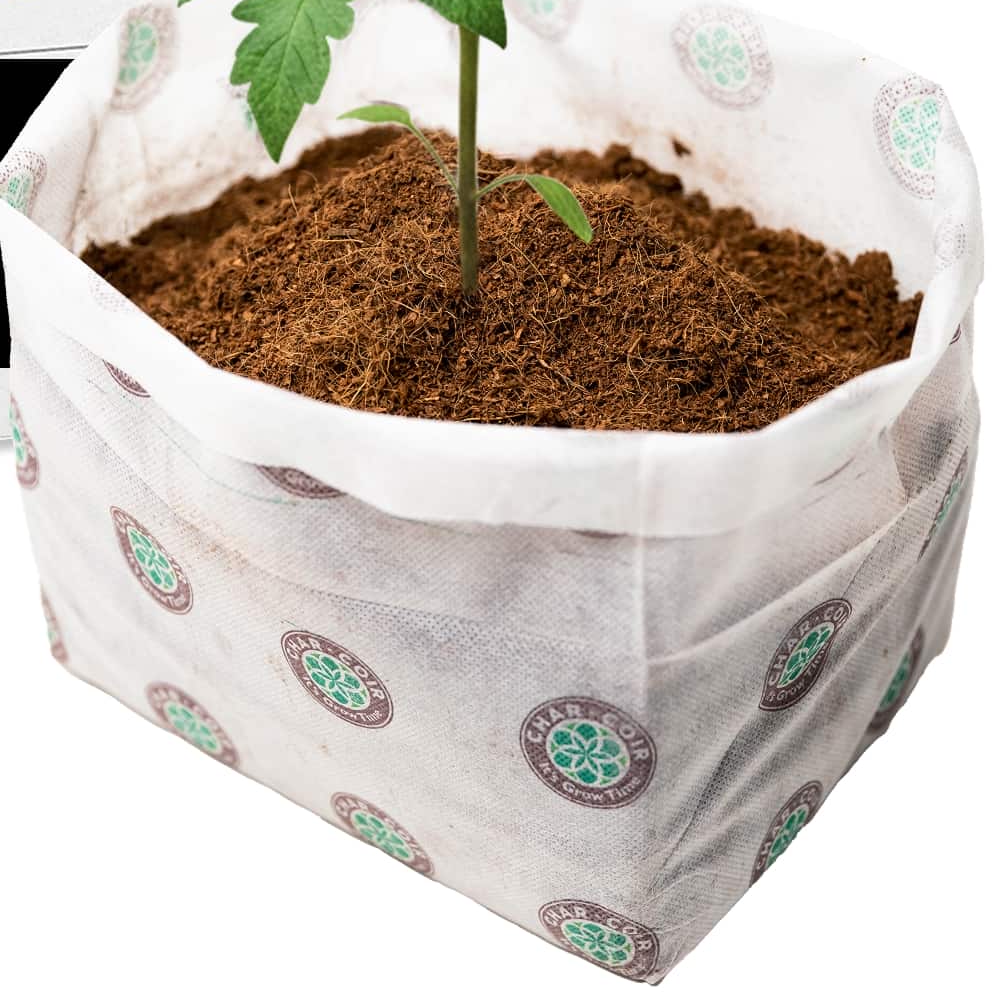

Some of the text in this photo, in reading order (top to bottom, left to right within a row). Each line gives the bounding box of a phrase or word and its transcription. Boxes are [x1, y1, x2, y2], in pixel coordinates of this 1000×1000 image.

[338, 652, 386, 701] COIR
[526, 703, 650, 761] CHAR COIR
